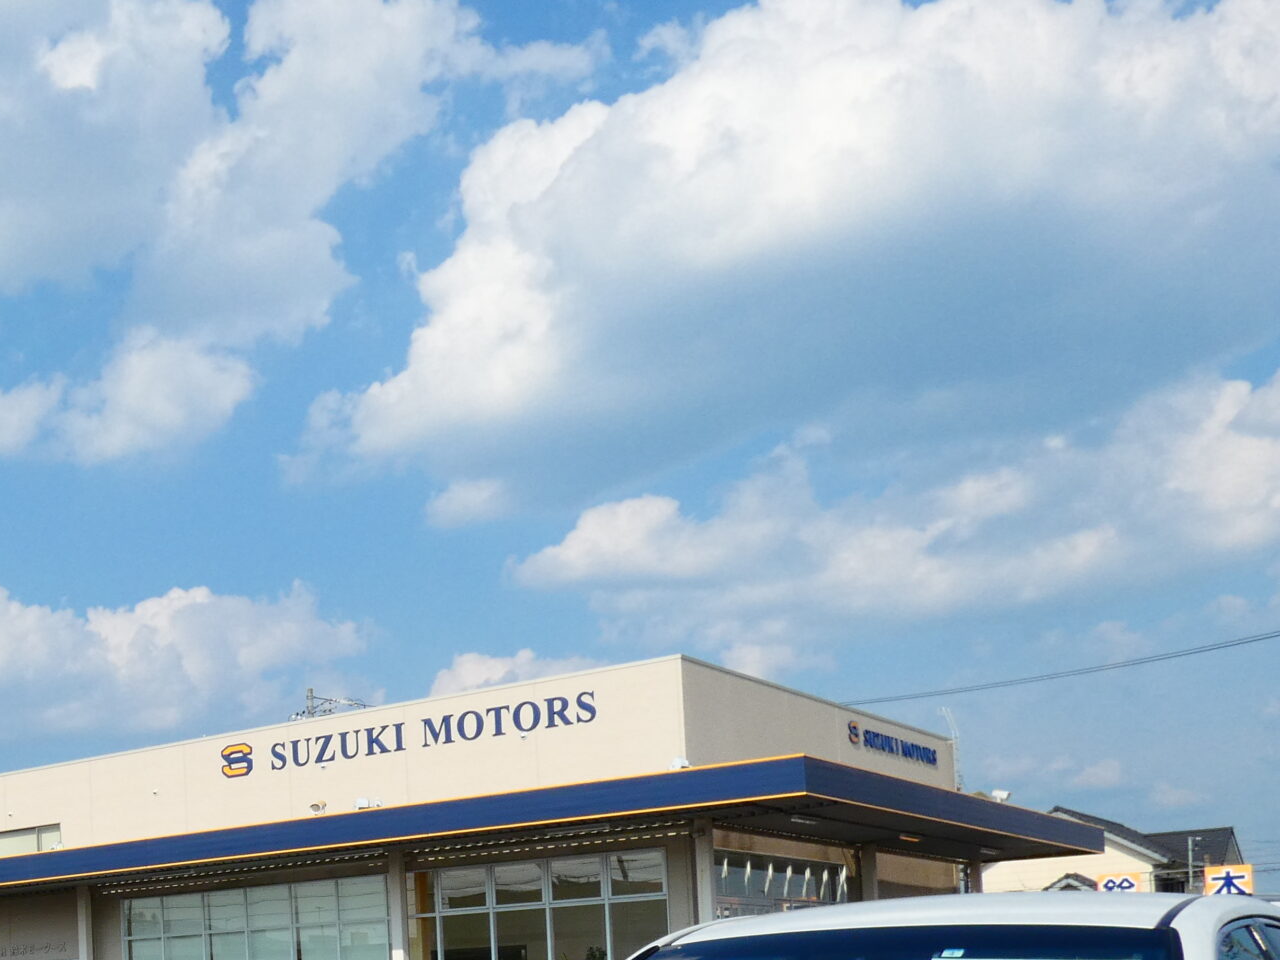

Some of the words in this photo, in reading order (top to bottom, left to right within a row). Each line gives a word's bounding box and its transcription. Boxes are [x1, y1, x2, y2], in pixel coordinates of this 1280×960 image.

[270, 722, 407, 771] SUZUKI
[420, 690, 597, 748] MOTORS
[863, 729, 900, 757] SUZUKI
